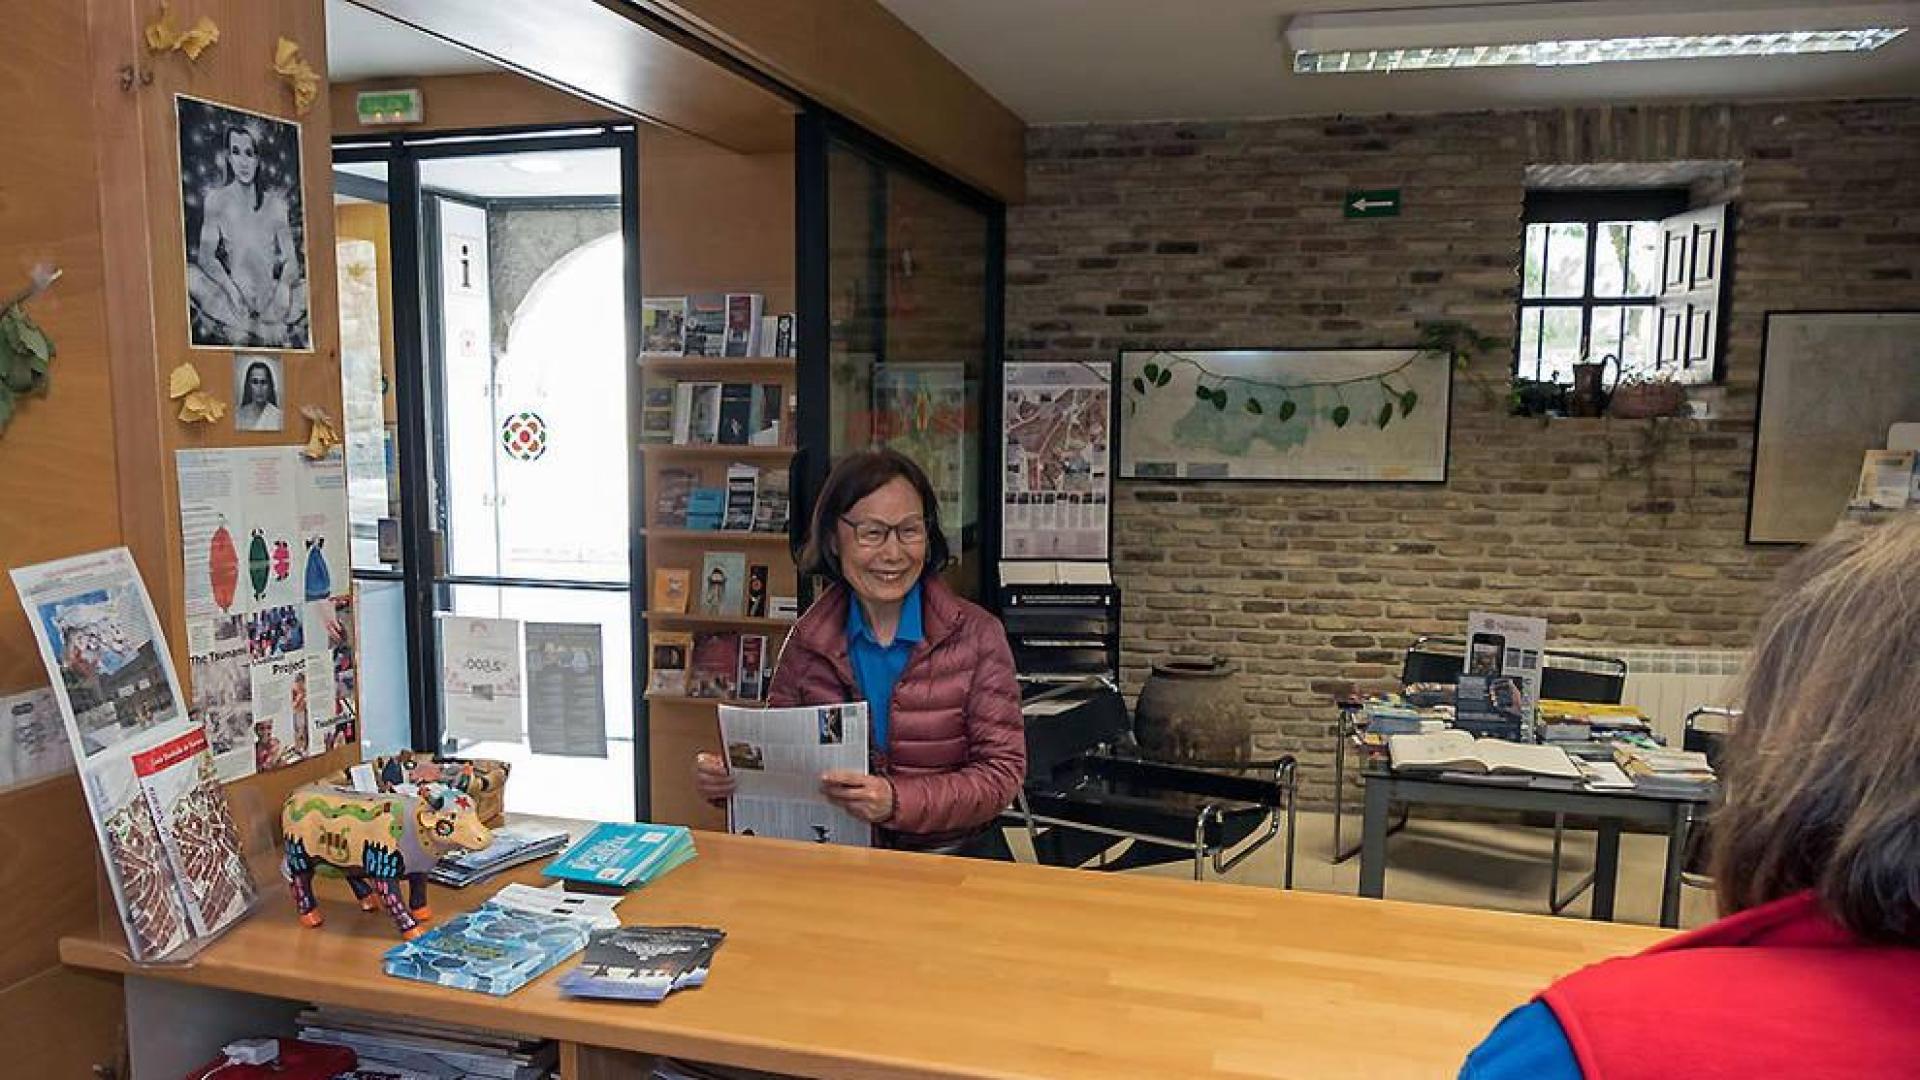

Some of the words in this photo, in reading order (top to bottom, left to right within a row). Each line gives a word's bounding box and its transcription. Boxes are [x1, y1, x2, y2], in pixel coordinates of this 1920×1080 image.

[189, 654, 207, 665] The
[209, 647, 247, 662] Tsunami
[273, 658, 305, 675] Project
